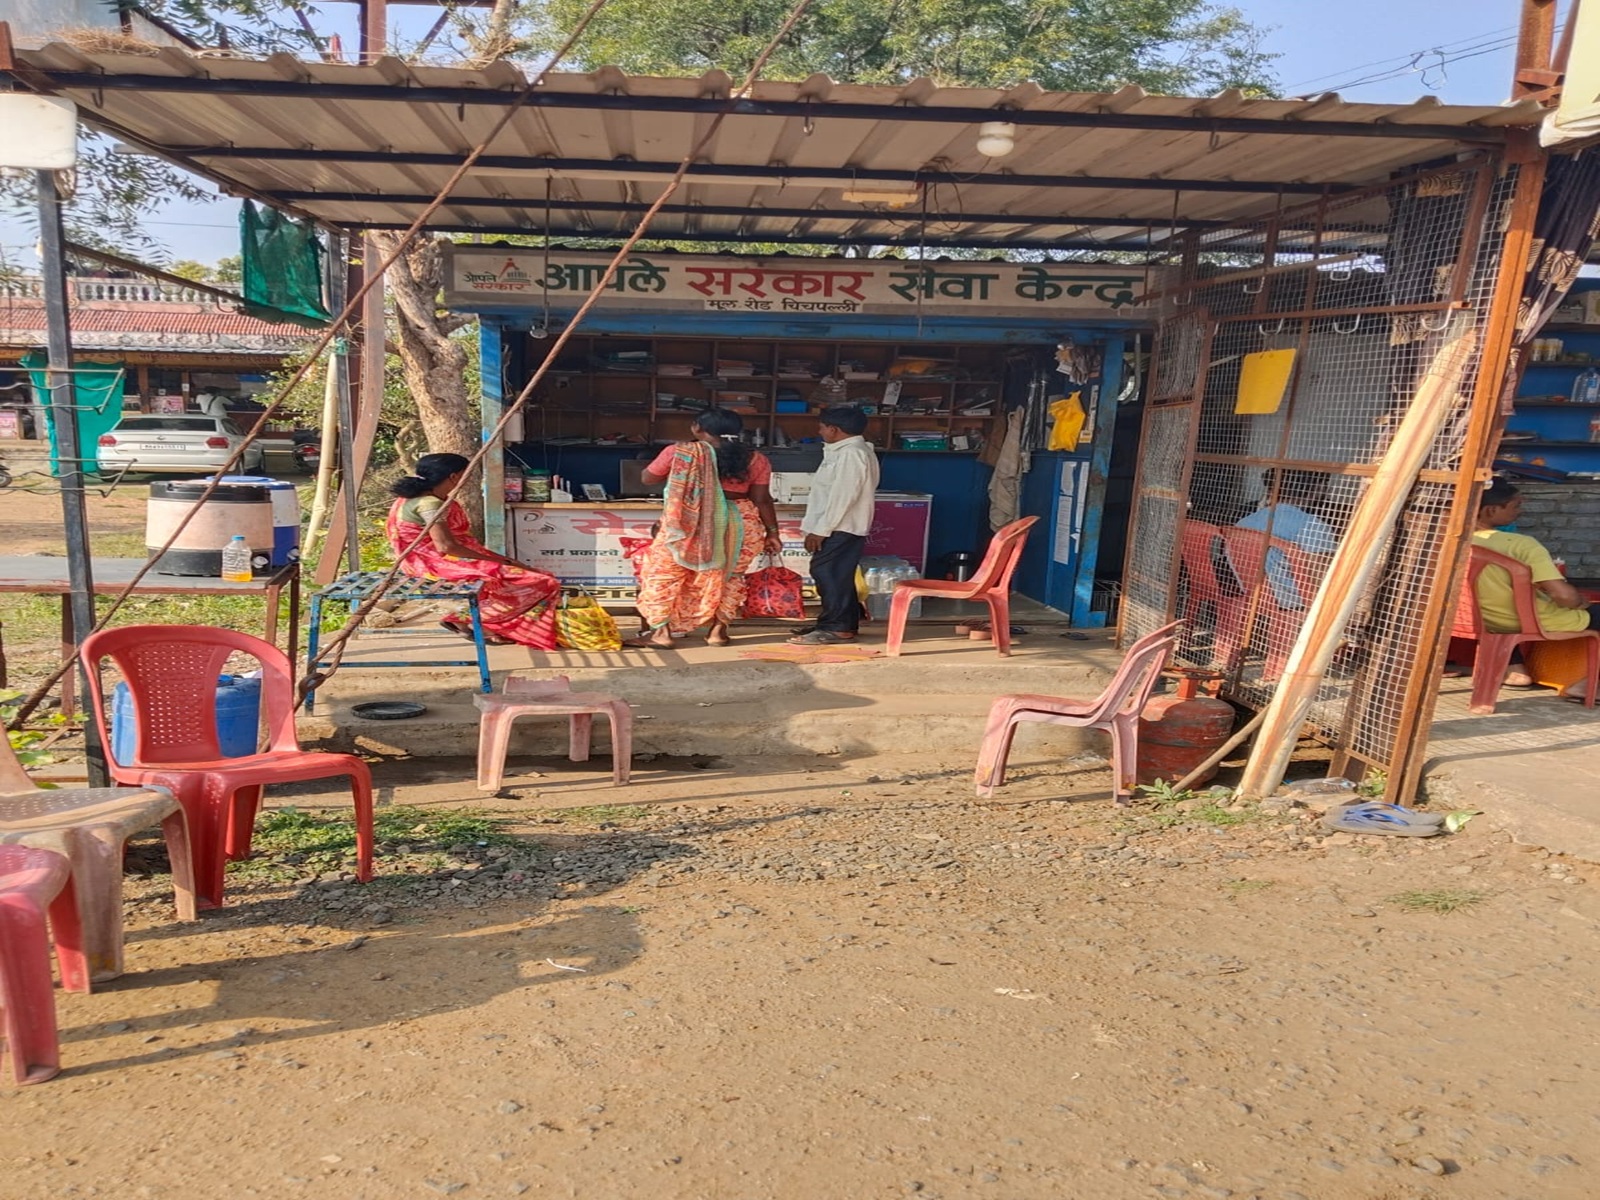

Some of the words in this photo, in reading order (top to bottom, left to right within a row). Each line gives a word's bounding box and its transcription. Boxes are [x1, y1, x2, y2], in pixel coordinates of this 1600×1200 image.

[472, 281, 531, 291] सरकार
[535, 258, 670, 293] आपले
[685, 266, 875, 301] सरकार
[888, 265, 999, 302] सेवा
[1014, 266, 1145, 310] केन्द्र
[707, 298, 739, 311] मूल
[744, 297, 774, 311] रोड
[782, 297, 860, 313] चिचपल्ली
